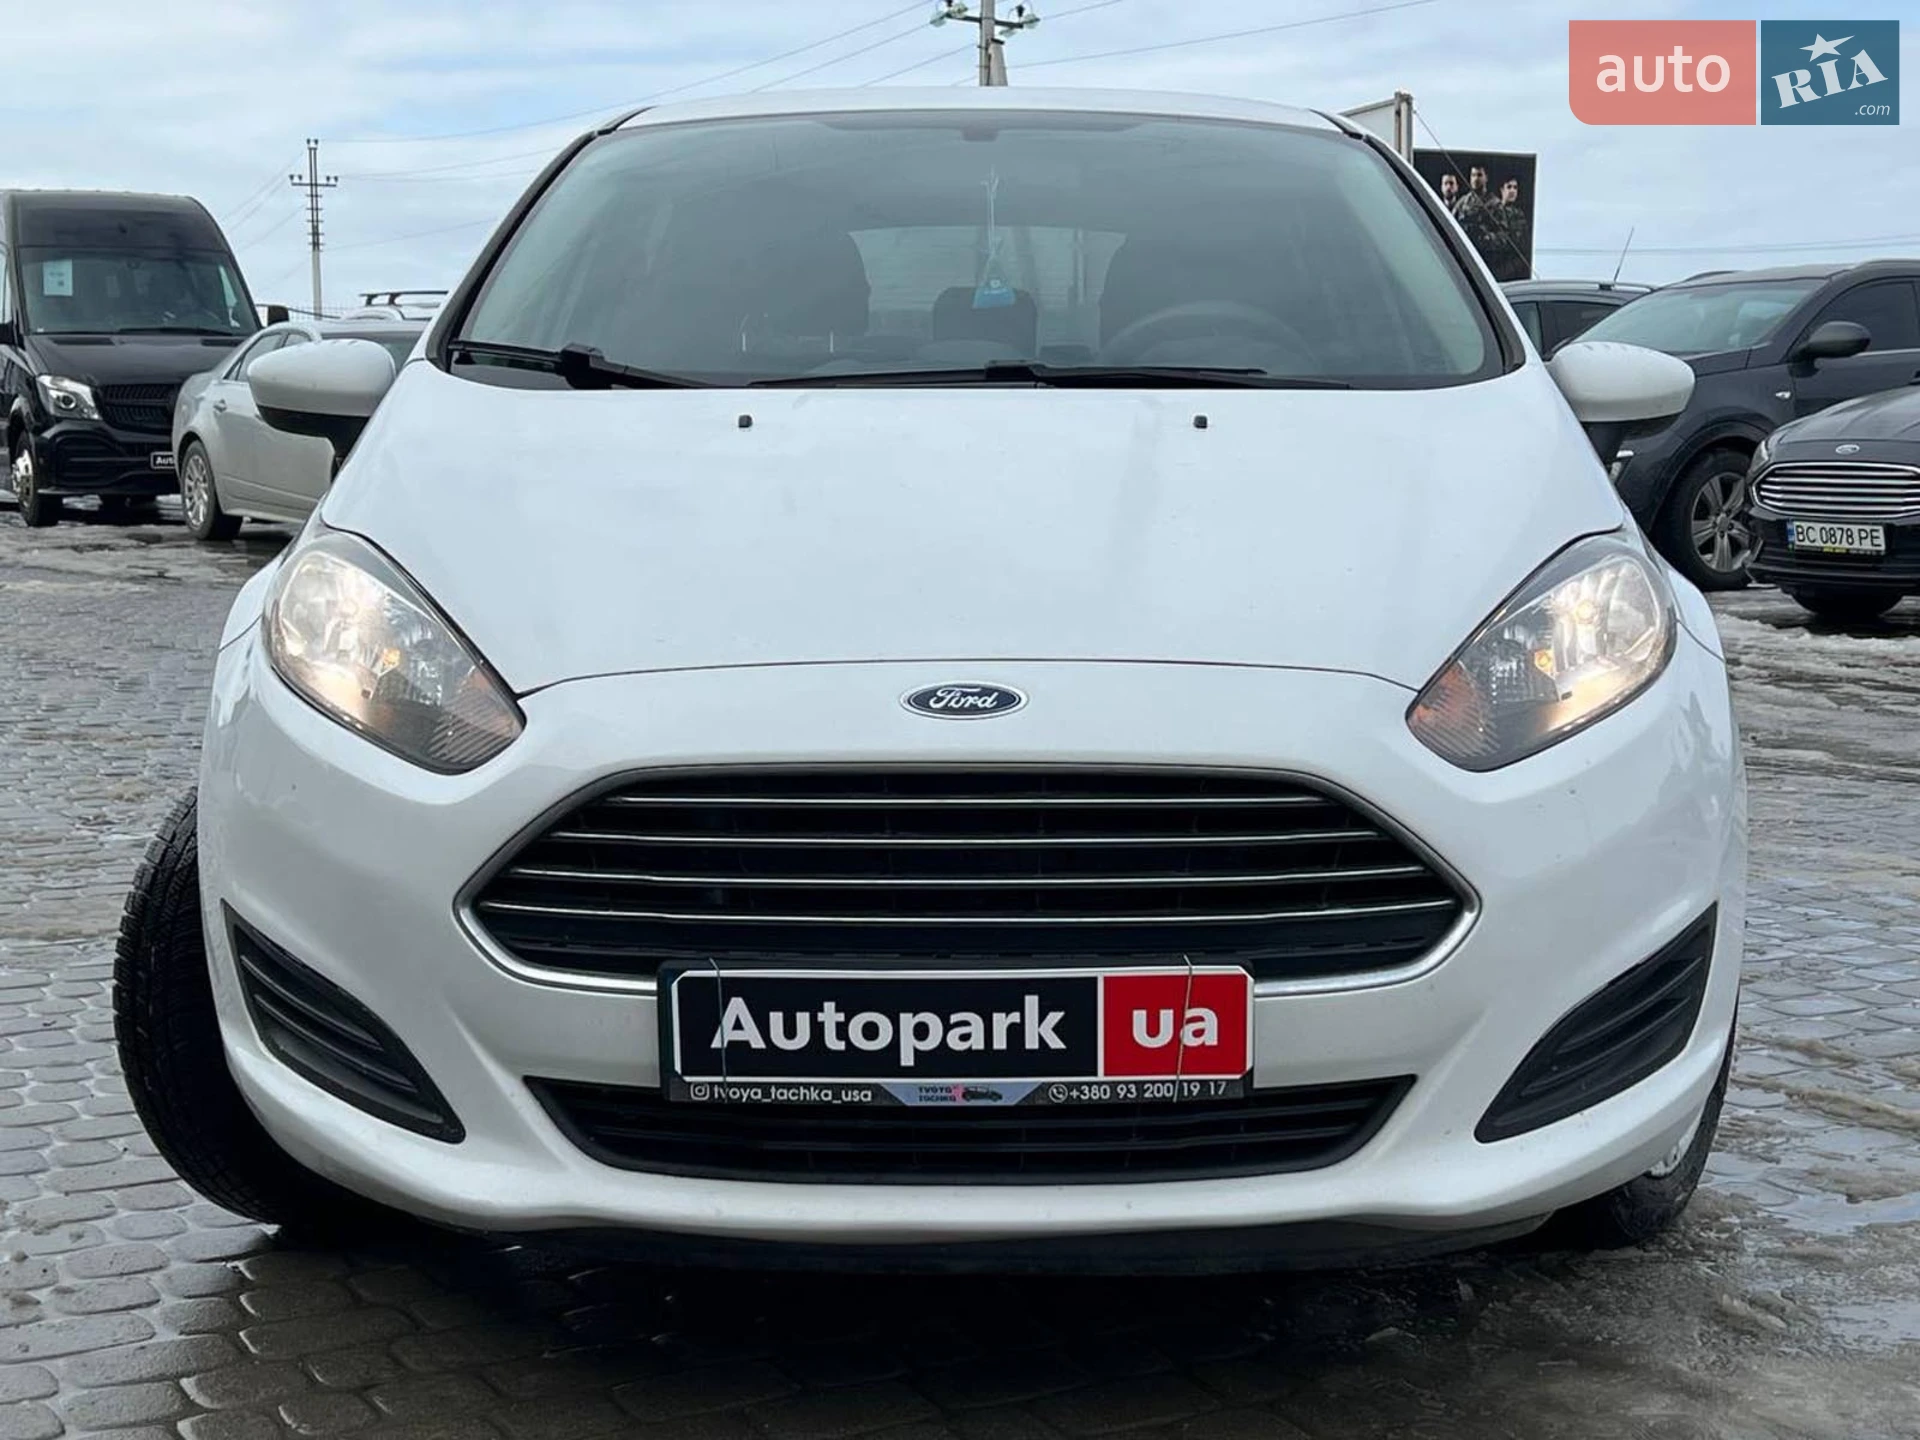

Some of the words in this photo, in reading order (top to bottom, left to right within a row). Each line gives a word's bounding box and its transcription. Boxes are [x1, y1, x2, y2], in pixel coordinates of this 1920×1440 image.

[1795, 525, 1816, 543] BC
[1819, 526, 1855, 546] 0878
[1858, 528, 1882, 548] PE
[929, 686, 998, 709] Ford
[710, 994, 1067, 1067] Autopark
[1132, 1007, 1218, 1049] ua
[1069, 1083, 1111, 1101] +380
[1117, 1083, 1138, 1099] 93
[1143, 1082, 1174, 1099] 200
[1182, 1081, 1200, 1097] 19
[1209, 1080, 1227, 1096] 17
